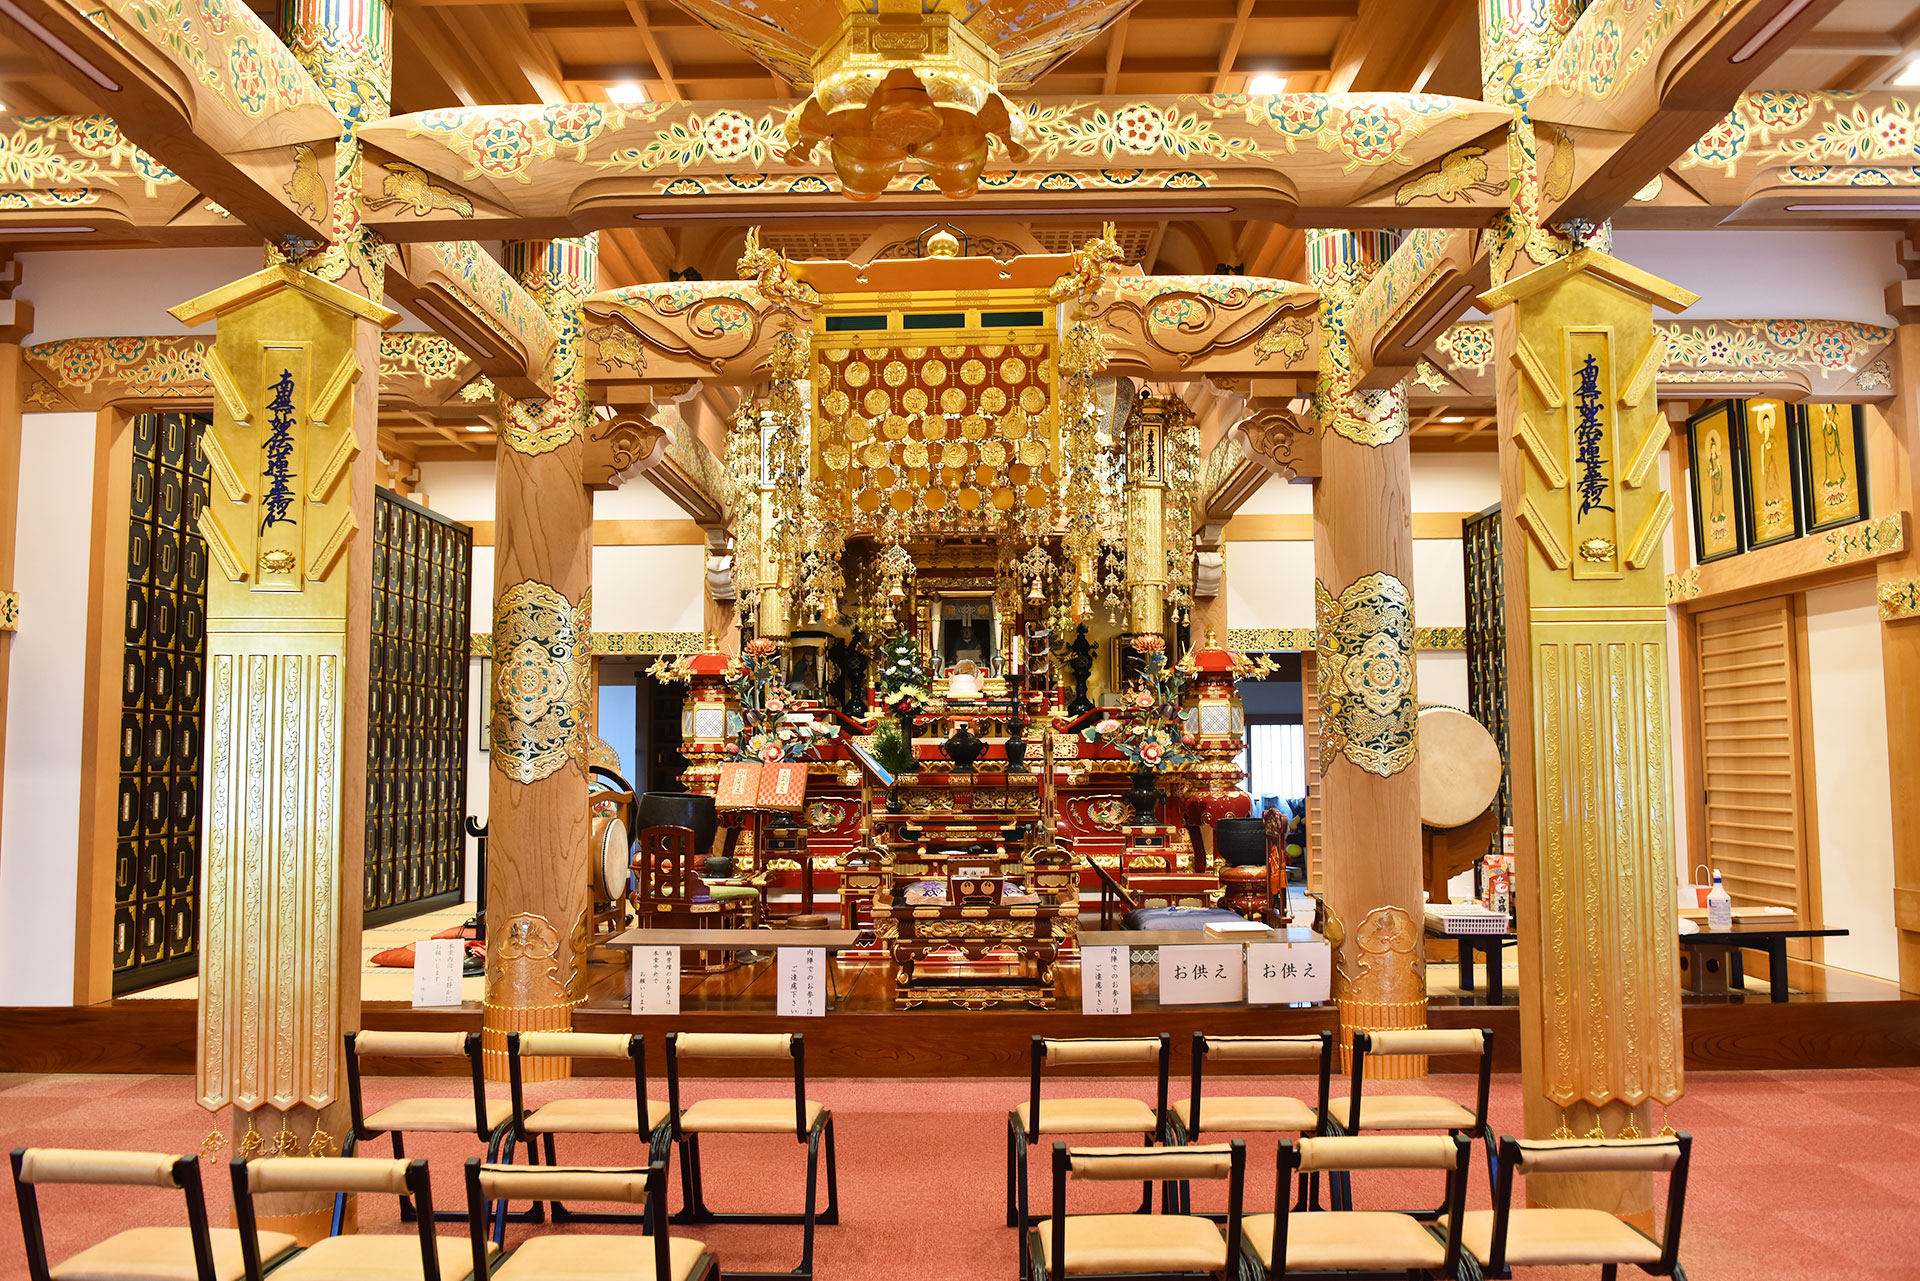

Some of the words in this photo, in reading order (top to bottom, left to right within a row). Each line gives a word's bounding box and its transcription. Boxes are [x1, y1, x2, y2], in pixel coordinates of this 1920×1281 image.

[790, 965, 798, 1014] ご遠慮下さい
[806, 949, 814, 1015] 内陣でのお参りは
[1095, 964, 1103, 1013] ご遠慮下さい
[1110, 947, 1119, 1014] 内陣でのお参りは
[1174, 963, 1227, 980] お供え
[1262, 962, 1316, 979] お供え
